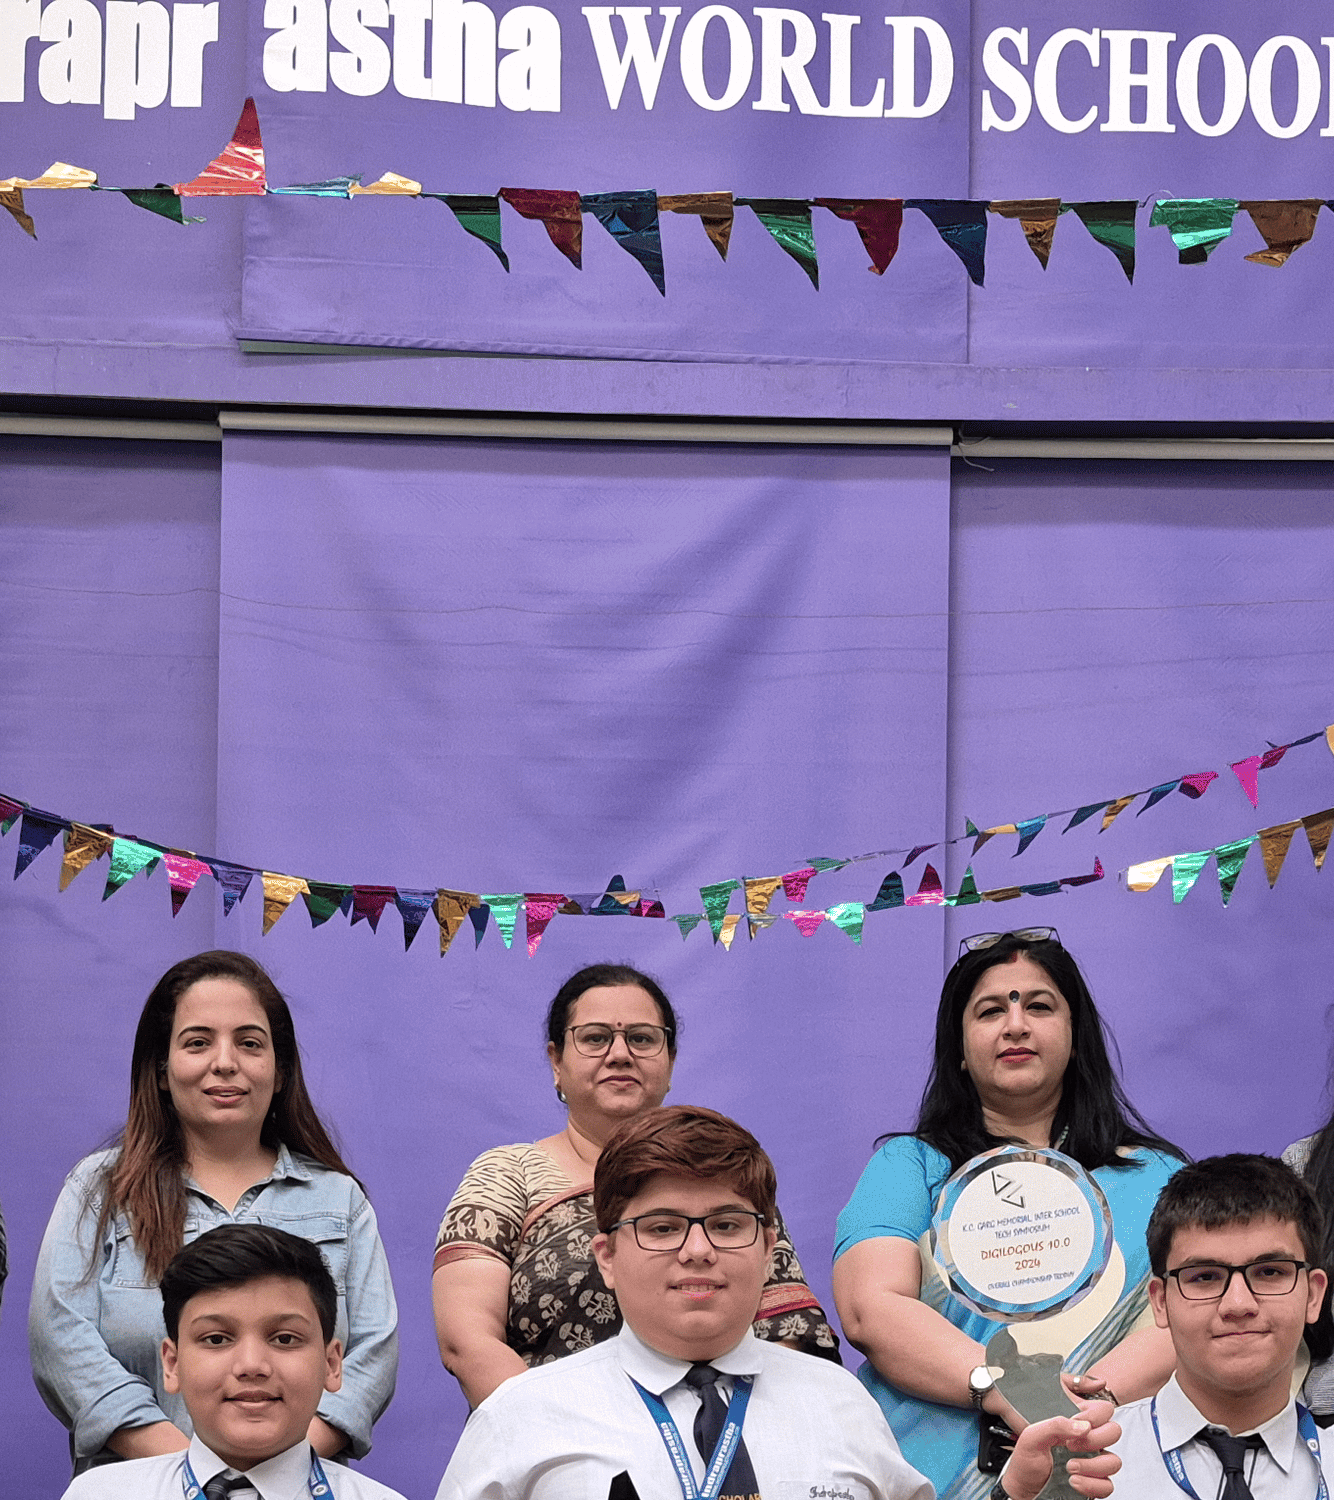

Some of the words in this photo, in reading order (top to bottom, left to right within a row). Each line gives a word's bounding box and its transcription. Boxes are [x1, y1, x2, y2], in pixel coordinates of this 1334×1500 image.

[581, 4, 955, 118] WORLD
[997, 1214, 1032, 1226] MEMORIAL
[1034, 1210, 1053, 1221] INTER
[1054, 1206, 1081, 1218] SCHOOL
[995, 1229, 1011, 1239] TECH
[1013, 1224, 1050, 1237] SYMPOSIUM
[980, 1241, 1044, 1260] DIGILOGOUS
[1048, 1237, 1071, 1250] 10.0
[1014, 1258, 1041, 1271] 2024
[660, 1422, 694, 1499] Indraprastha
[701, 1421, 736, 1498] Indraprastha
